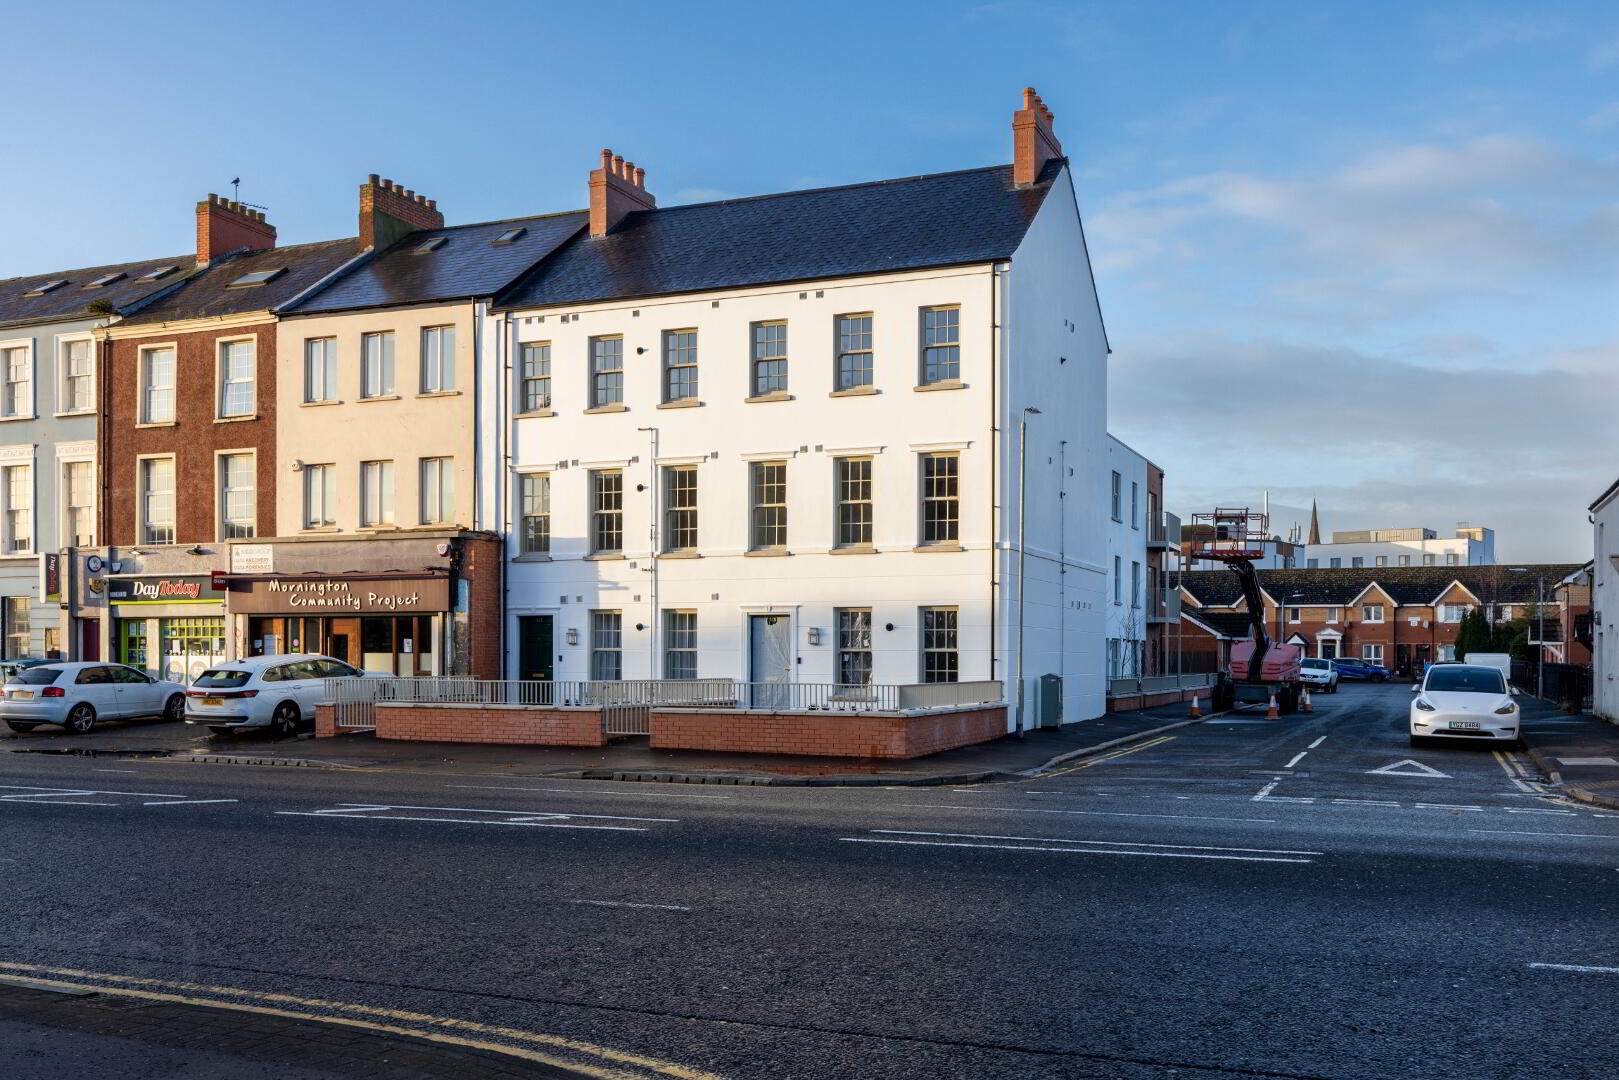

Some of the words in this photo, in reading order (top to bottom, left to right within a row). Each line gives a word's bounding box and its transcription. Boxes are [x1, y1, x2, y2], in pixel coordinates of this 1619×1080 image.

[268, 579, 349, 595] Mornington
[290, 594, 361, 609] Community
[369, 592, 419, 609] Project
